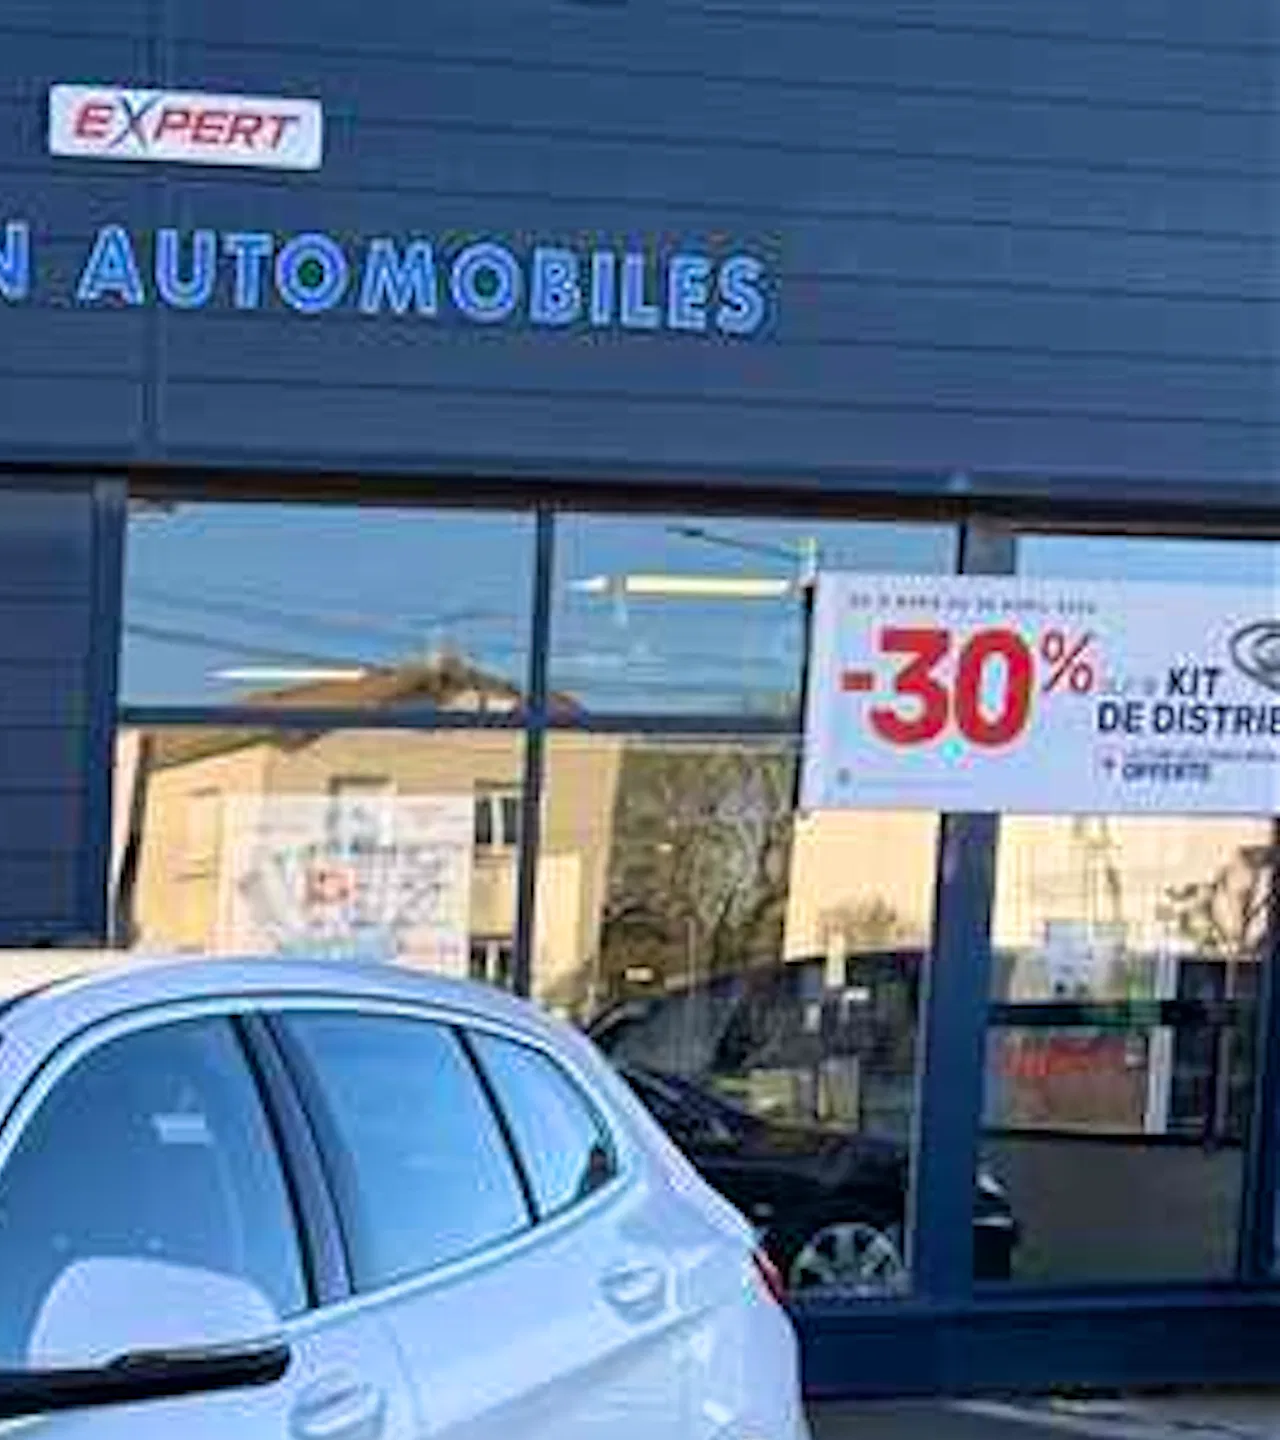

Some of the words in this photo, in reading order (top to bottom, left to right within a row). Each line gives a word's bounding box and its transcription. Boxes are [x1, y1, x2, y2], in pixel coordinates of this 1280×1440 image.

[74, 97, 302, 152] EXPERT
[75, 224, 771, 335] AUTOMOBILES
[841, 628, 1095, 748] -30%
[1168, 666, 1223, 697] KIT
[1098, 701, 1145, 732] DE
